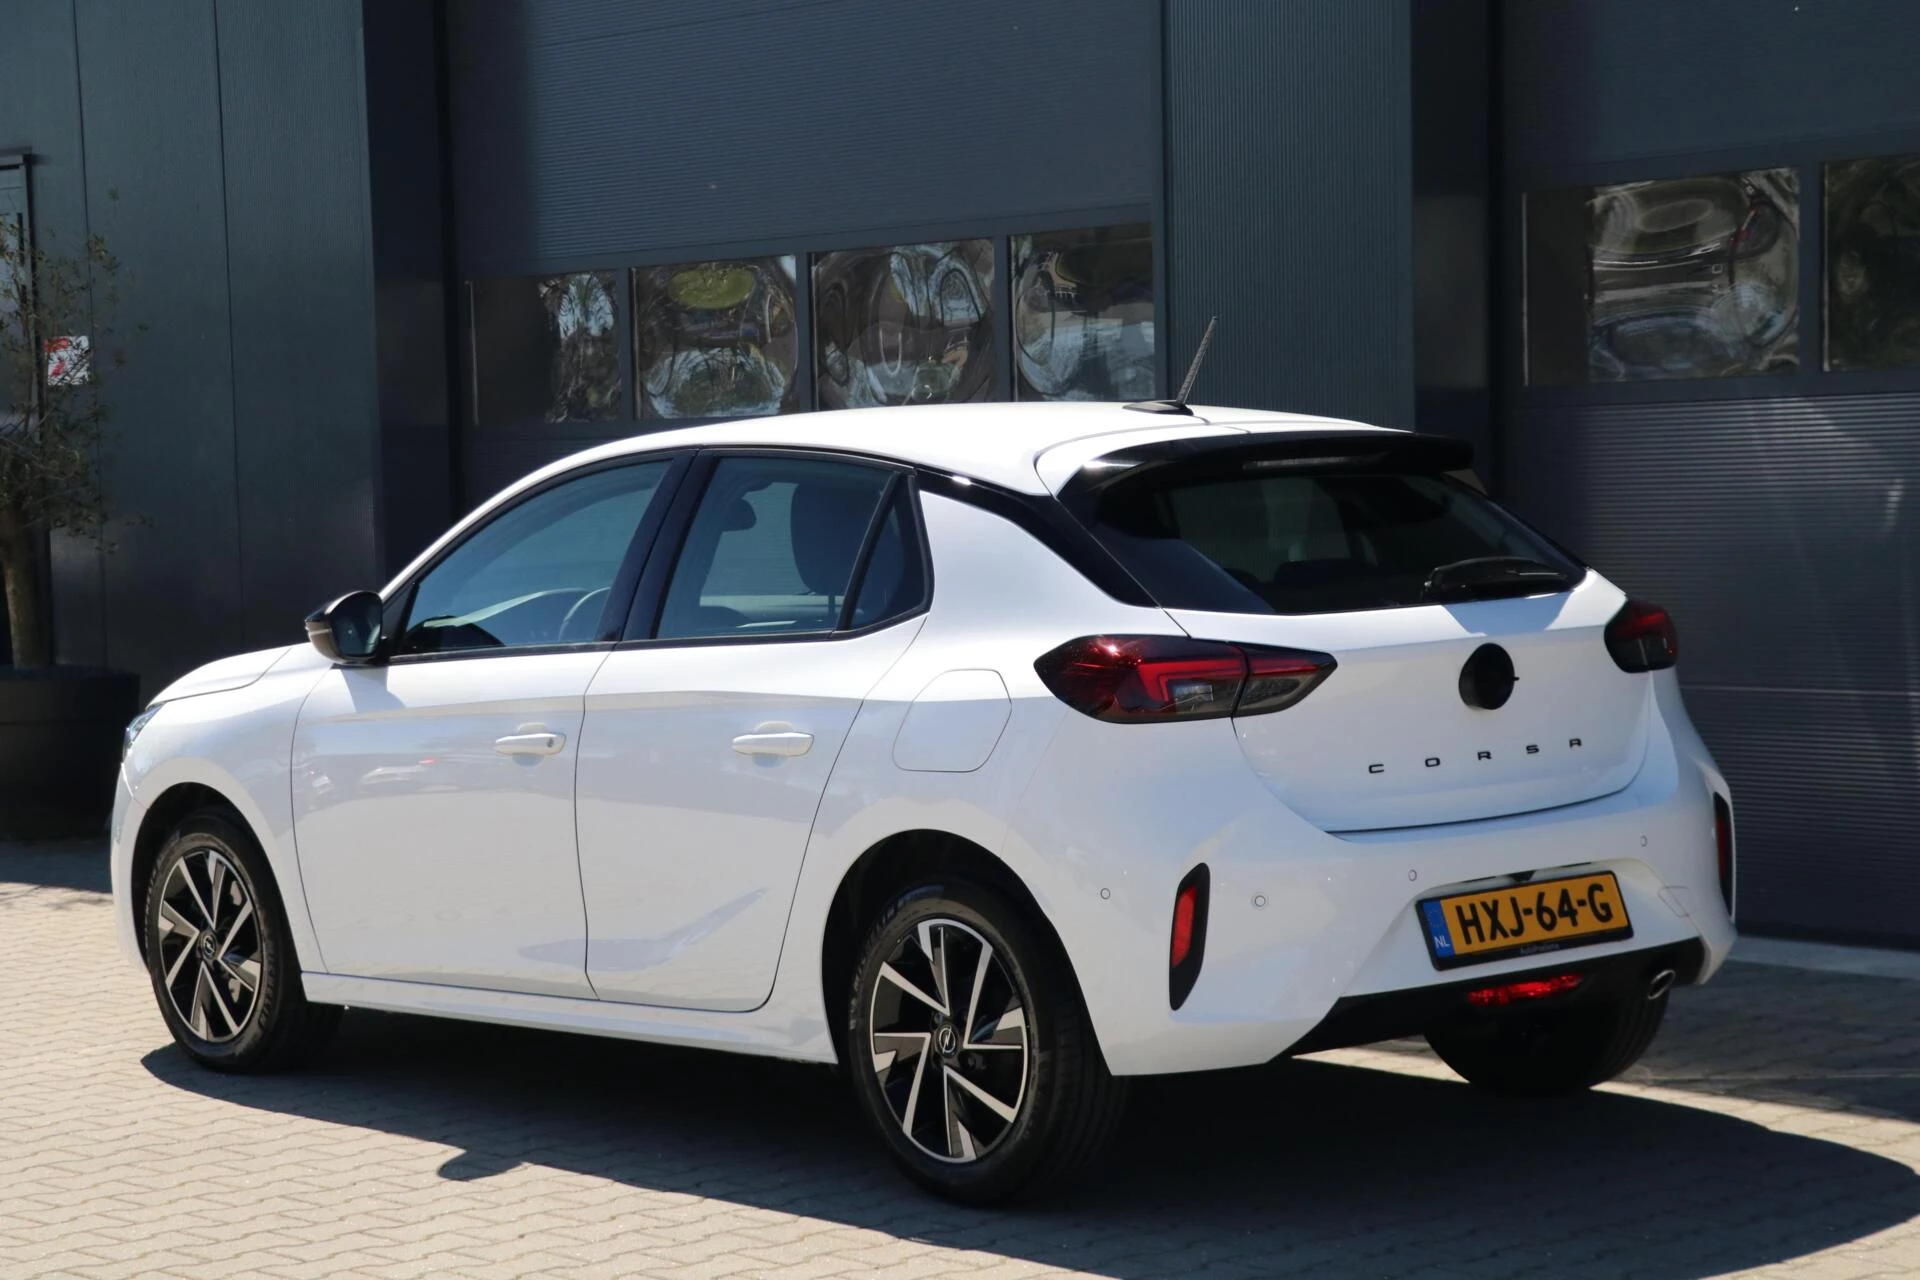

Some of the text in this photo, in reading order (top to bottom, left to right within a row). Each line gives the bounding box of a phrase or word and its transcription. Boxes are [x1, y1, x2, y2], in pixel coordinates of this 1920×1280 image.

[1368, 738, 1582, 774] CORSA
[1455, 883, 1613, 945] HXJ-64-G
[1433, 935, 1451, 949] NL
